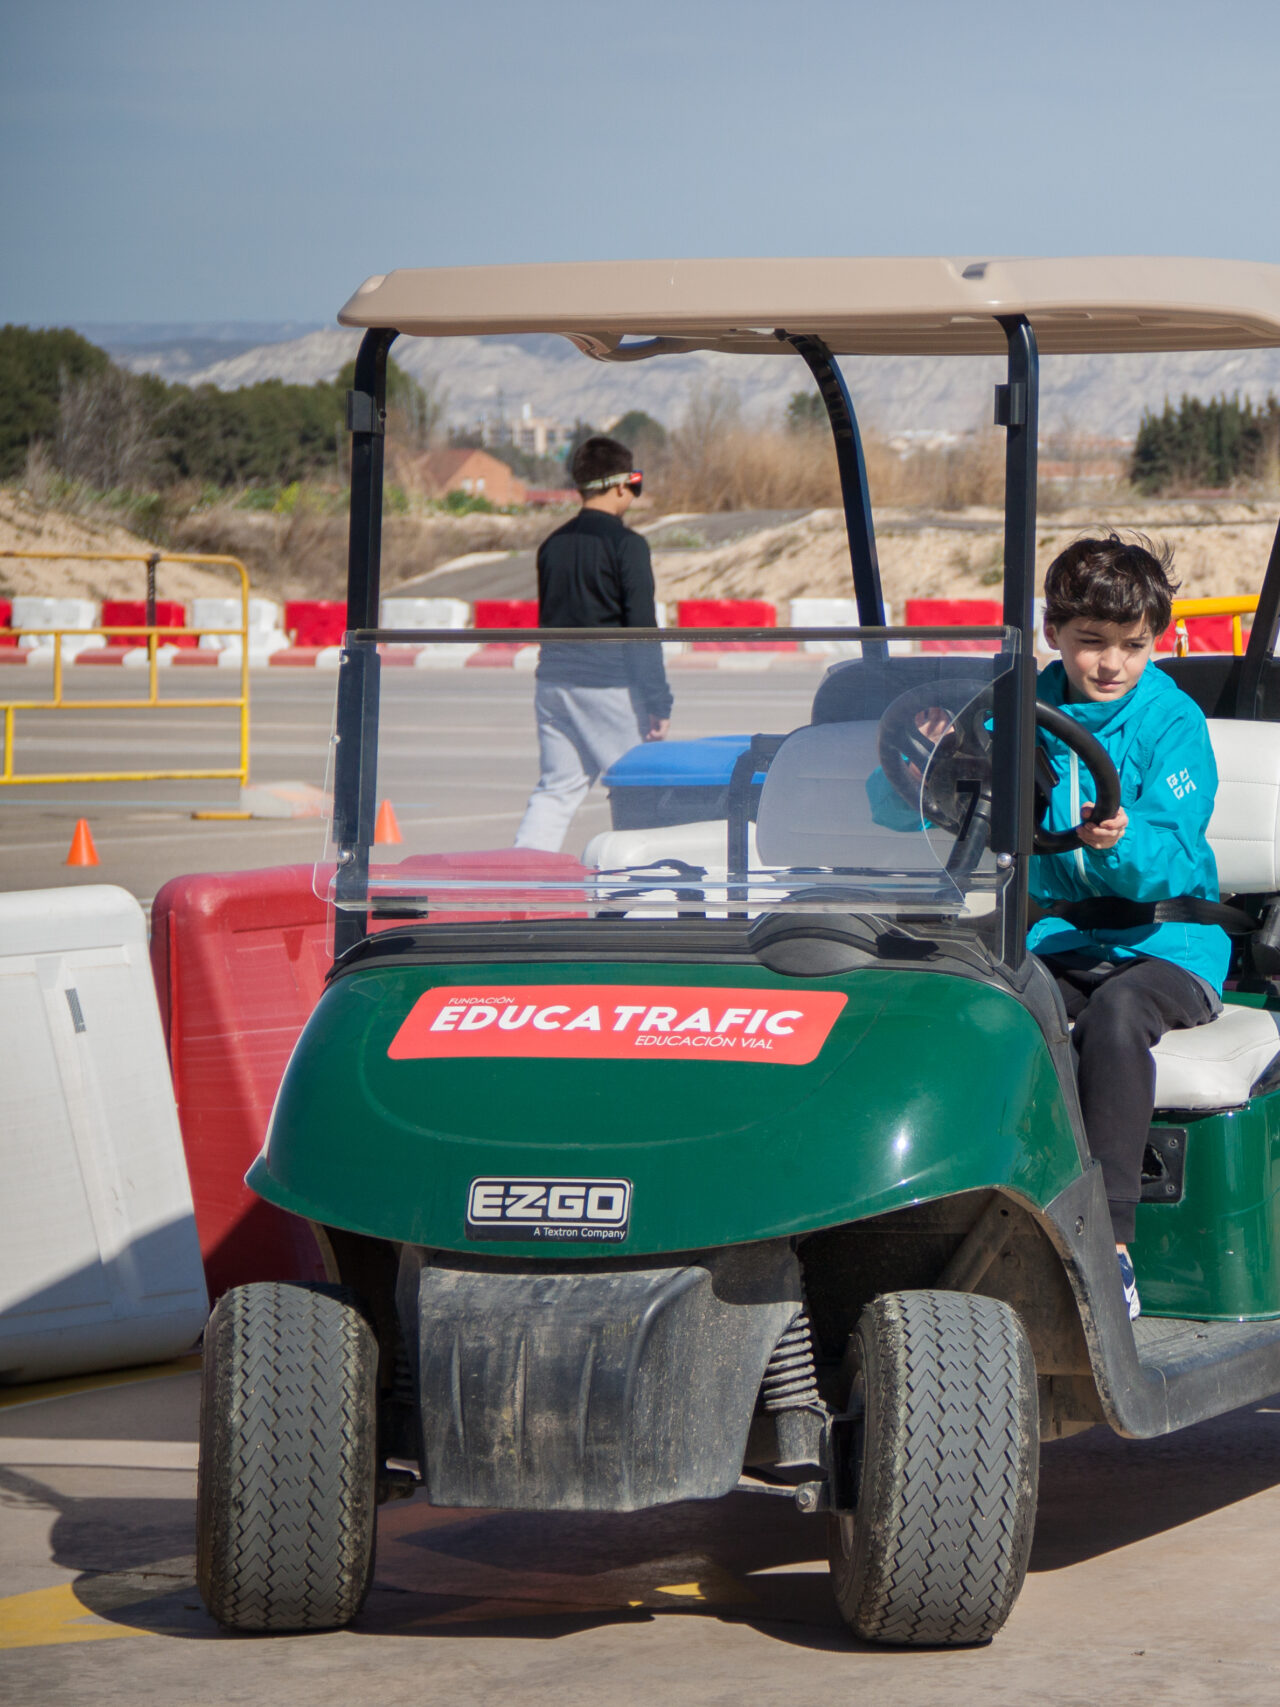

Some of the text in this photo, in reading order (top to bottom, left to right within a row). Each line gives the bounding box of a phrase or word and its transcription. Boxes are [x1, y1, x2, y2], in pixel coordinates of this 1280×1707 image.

[956, 780, 982, 841] 7
[449, 996, 516, 1005] FUNDACIÓN
[634, 1034, 774, 1050] EDUCACIÓN VIAL
[533, 1227, 626, 1240] A Textron Company
